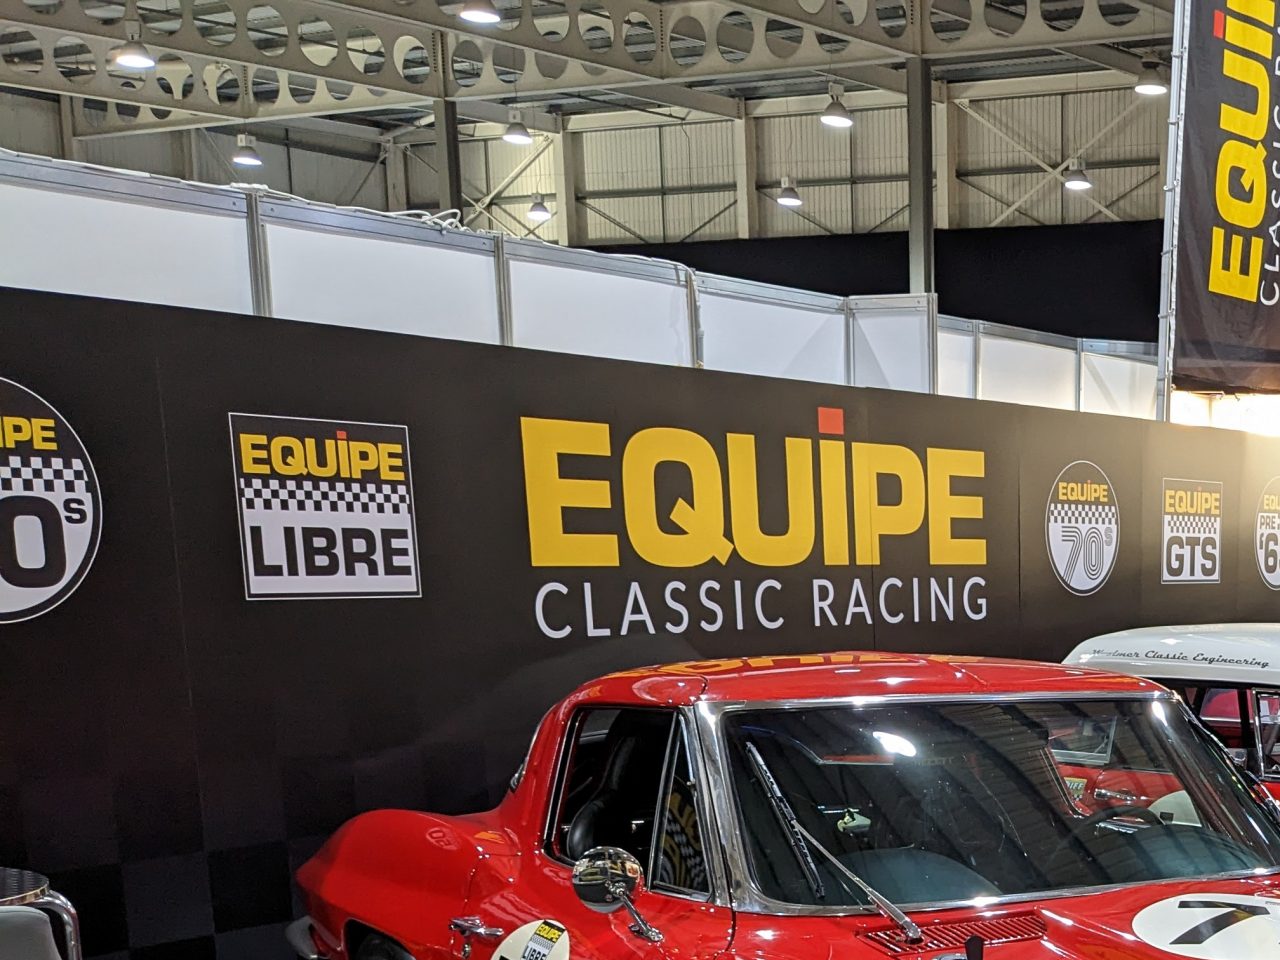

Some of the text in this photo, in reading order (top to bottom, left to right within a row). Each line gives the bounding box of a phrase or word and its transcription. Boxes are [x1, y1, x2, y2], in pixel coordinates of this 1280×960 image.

[239, 430, 406, 481] EQUIPE
[520, 406, 988, 568] EQUIPE
[1058, 479, 1109, 503] EQUIPE
[1165, 486, 1220, 515] EQUIPE
[1259, 514, 1276, 530] PRE
[249, 525, 412, 577] LIBRE
[1166, 535, 1217, 577] GTS
[534, 576, 989, 639] CLASSIC RACING
[1144, 650, 1188, 661] Classic
[1193, 652, 1269, 668] Engineering
[535, 922, 563, 943] EQUIPE
